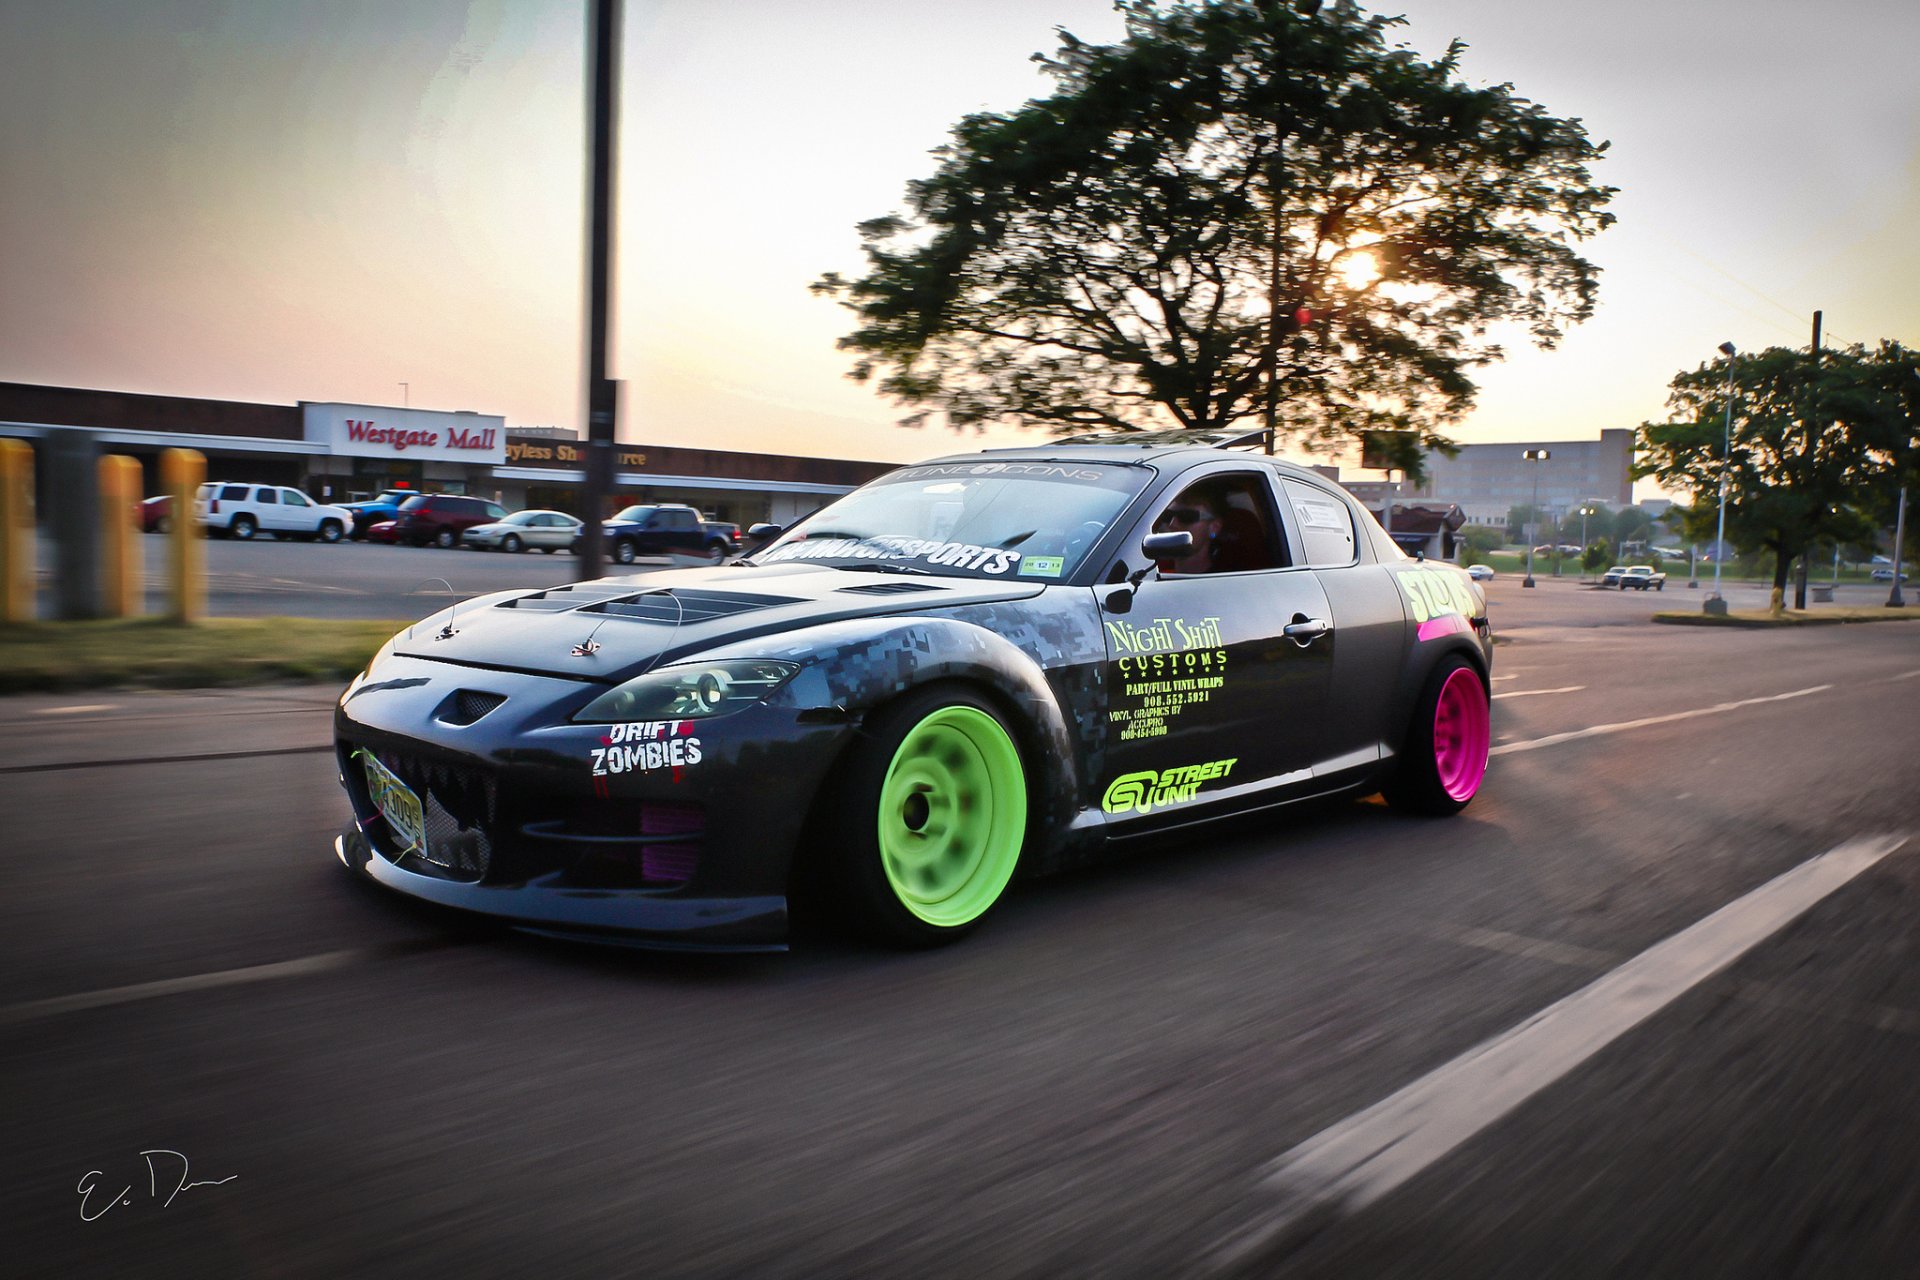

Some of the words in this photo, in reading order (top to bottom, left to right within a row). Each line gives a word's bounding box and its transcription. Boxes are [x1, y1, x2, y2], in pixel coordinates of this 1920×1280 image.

[345, 419, 438, 450] Westgate
[445, 427, 496, 450] Mall
[505, 443, 551, 461] ayless
[1118, 651, 1227, 670] CUSTOMS
[1126, 681, 1172, 696] PART/FULL
[1173, 679, 1197, 691] VINYL
[1197, 676, 1224, 689] WRAPS
[1133, 706, 1170, 719] GRAPHICS
[1171, 705, 1182, 715] BY
[610, 720, 684, 744] DRIFT
[590, 737, 703, 777] ZOMBIES
[1158, 758, 1238, 788] STREET
[1154, 782, 1202, 806] UNIT
